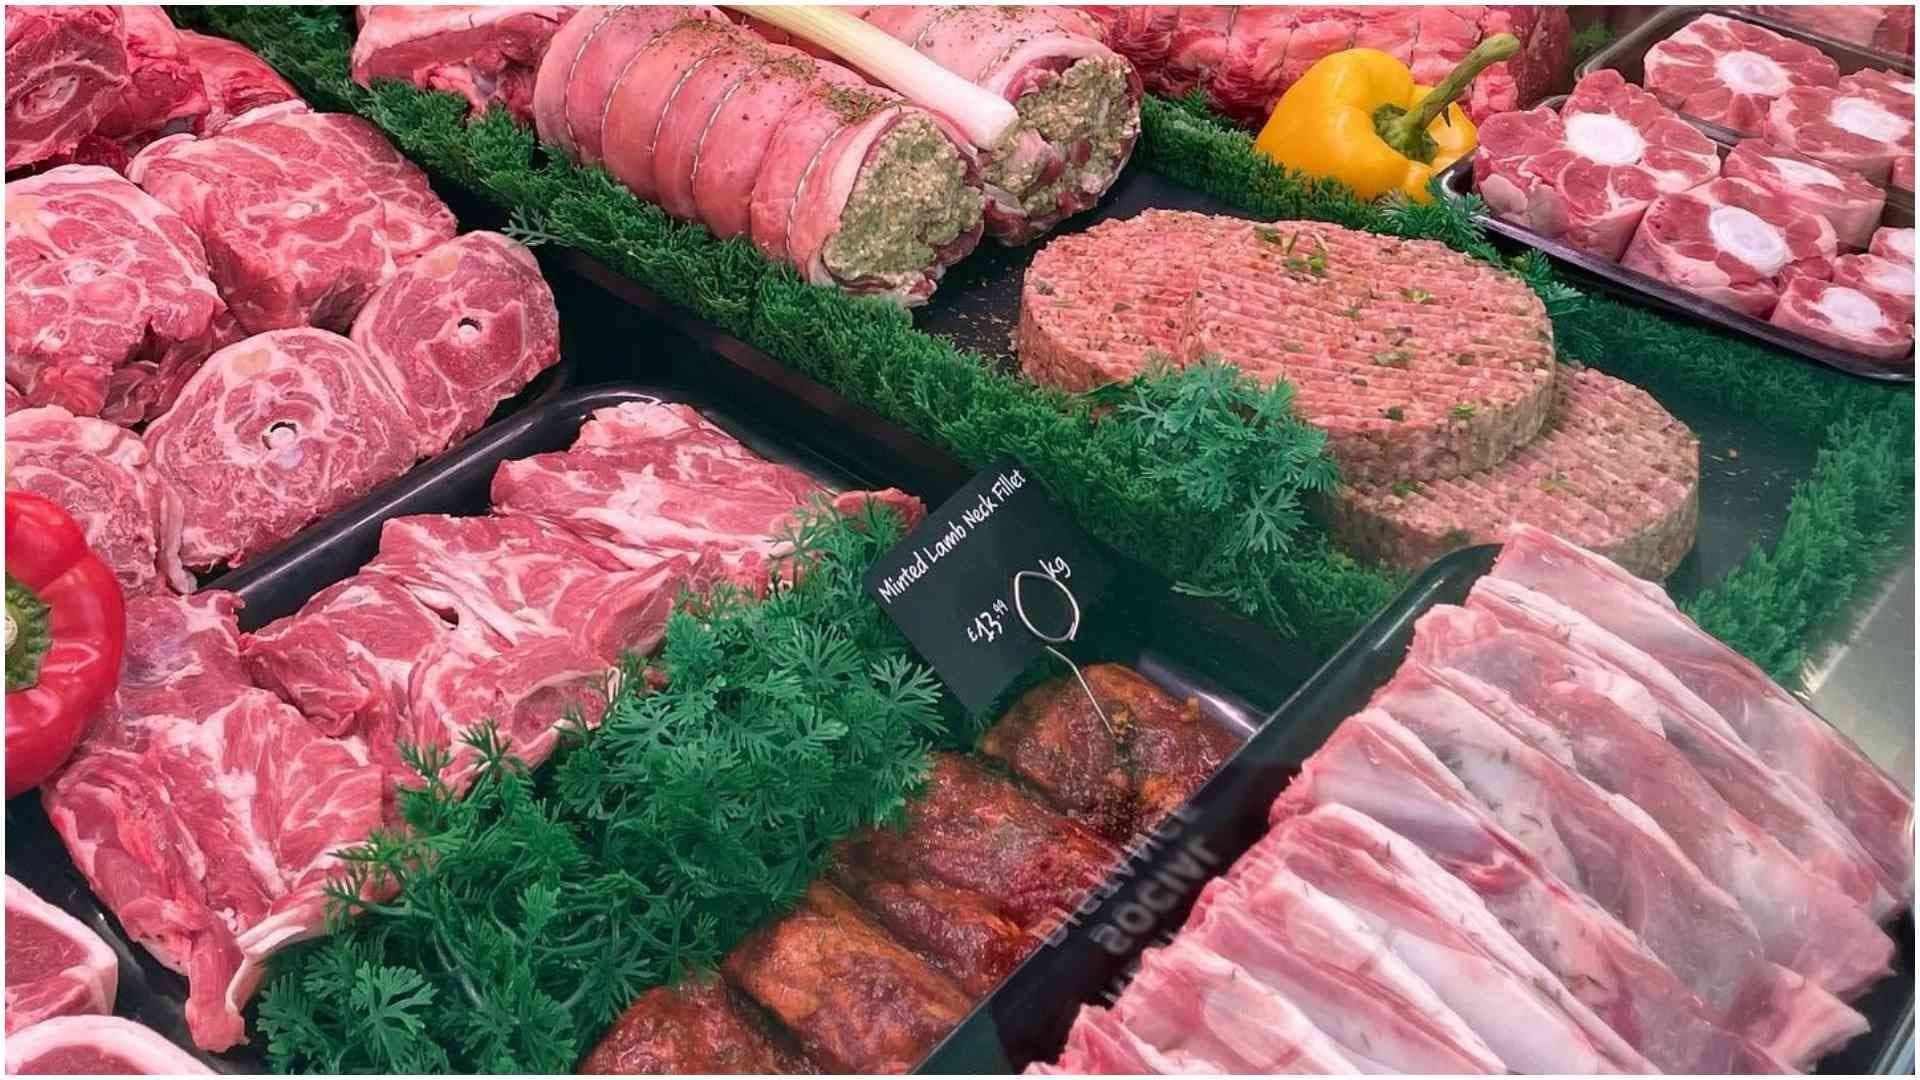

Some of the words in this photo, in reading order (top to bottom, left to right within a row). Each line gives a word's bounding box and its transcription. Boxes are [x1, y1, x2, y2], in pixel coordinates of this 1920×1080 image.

[879, 551, 929, 604] Minted
[923, 520, 967, 562] Lamb
[961, 494, 999, 529] Neck
[991, 469, 1026, 502] Fillet
[1038, 556, 1071, 580] kg
